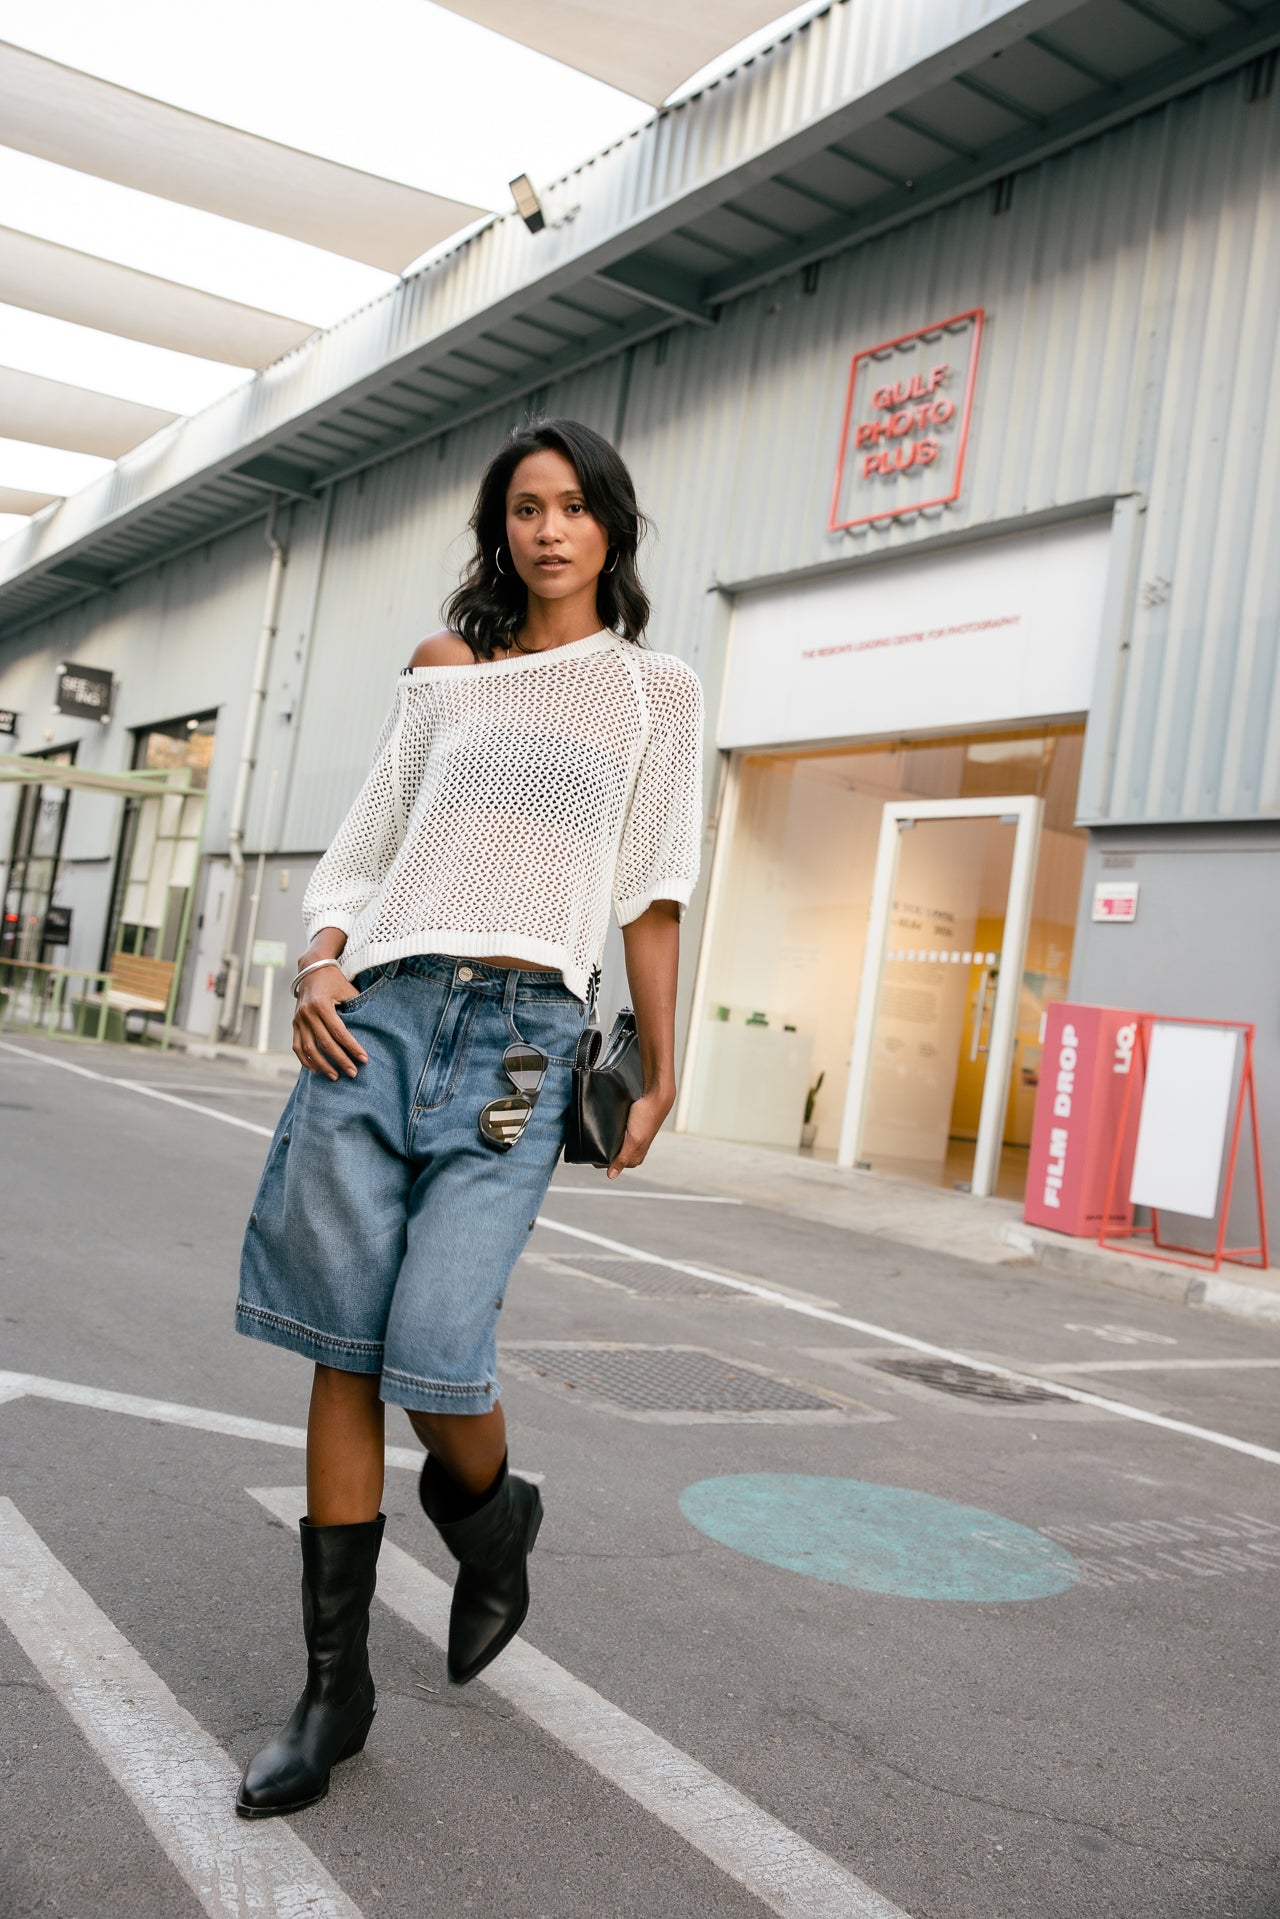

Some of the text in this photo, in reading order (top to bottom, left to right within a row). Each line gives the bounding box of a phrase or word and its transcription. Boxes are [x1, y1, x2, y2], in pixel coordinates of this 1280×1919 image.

[872, 363, 950, 410] GULF
[855, 399, 955, 448] PHOTO
[862, 438, 939, 480] PLUS
[1043, 1023, 1079, 1208] FILM DROP
